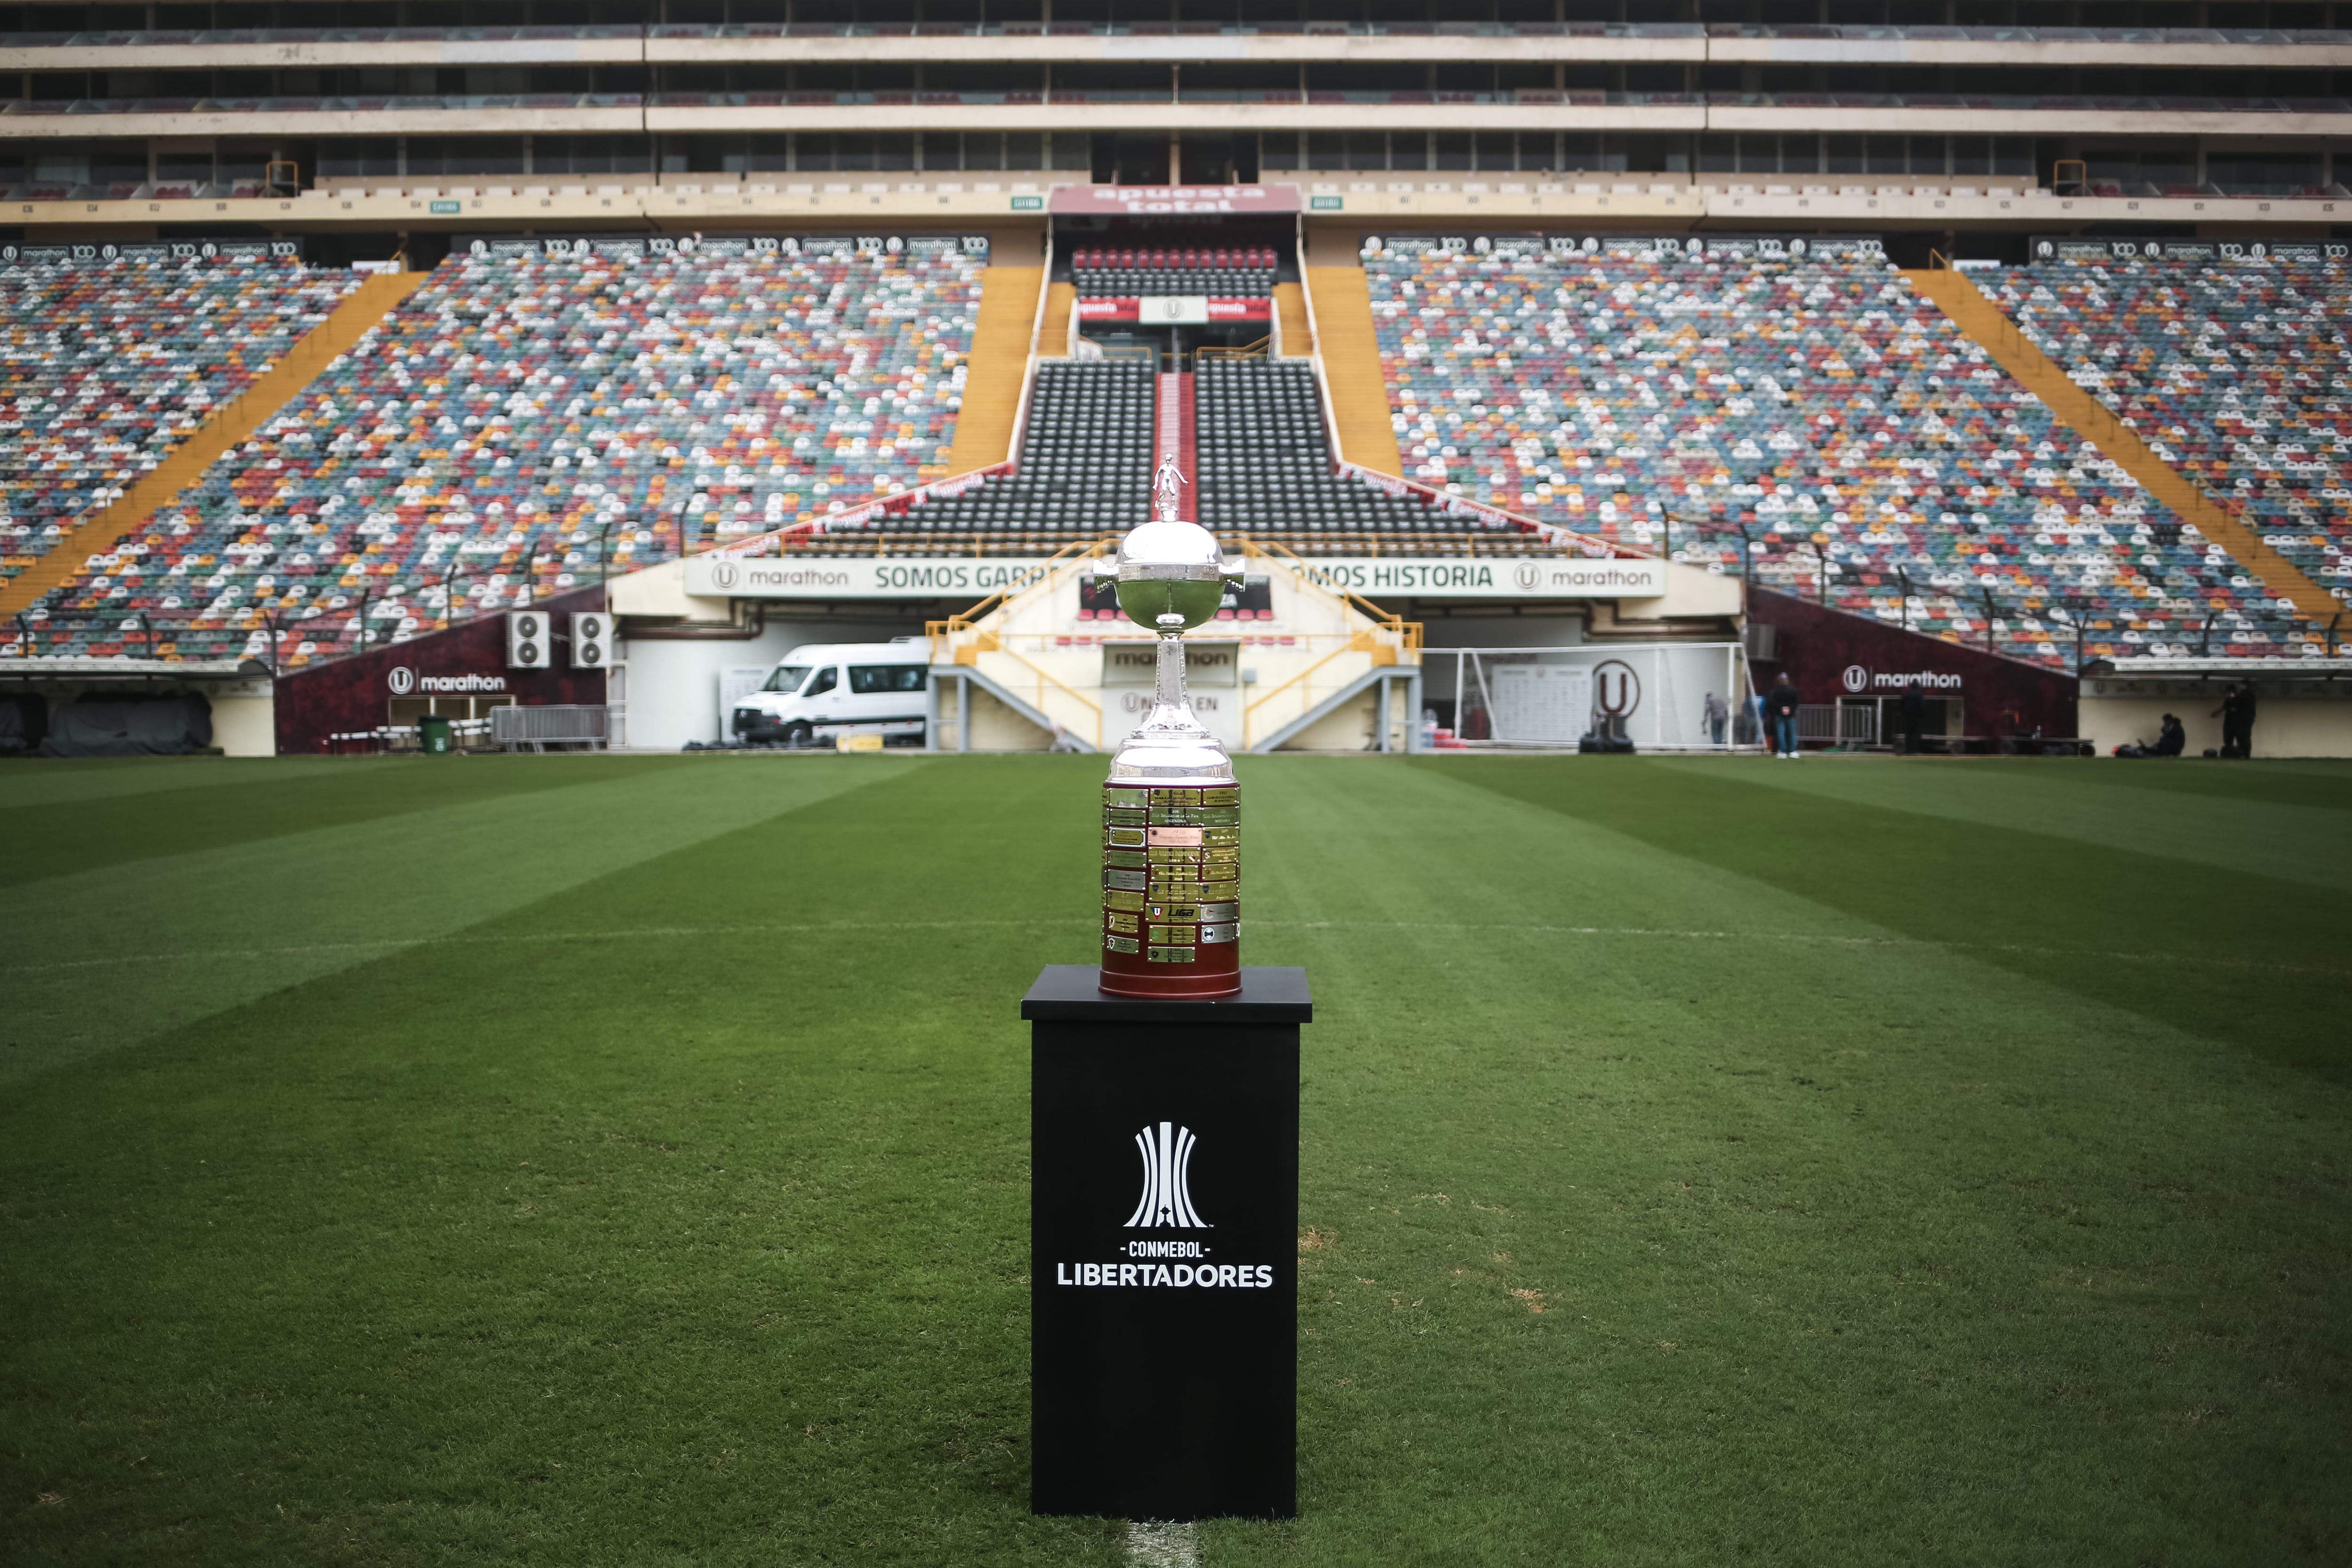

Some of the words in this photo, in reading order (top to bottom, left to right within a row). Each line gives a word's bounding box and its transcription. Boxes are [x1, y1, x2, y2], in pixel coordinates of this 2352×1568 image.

[1093, 186, 1265, 202] apuesta
[1128, 198, 1235, 213] total
[24, 249, 66, 257] marathon
[72, 245, 96, 258] 100
[123, 247, 167, 257] marathon
[171, 244, 196, 257] 100
[271, 242, 297, 256] 100
[648, 238, 675, 253] 100
[1440, 237, 1467, 251] 100
[1549, 238, 1575, 251] 100
[2112, 243, 2136, 257] 100
[2219, 244, 2243, 257] 100
[2274, 247, 2317, 256] marathon
[2324, 245, 2348, 257] 100
[719, 568, 732, 586] U
[749, 568, 849, 586] marathon
[875, 566, 968, 587] SOMOS
[976, 566, 1059, 587] GARR
[1375, 565, 1493, 587] HISTORIA
[1520, 567, 1534, 586] U
[1552, 568, 1652, 585] marathon
[1115, 650, 1229, 666] mahon
[393, 672, 408, 689] U
[421, 673, 506, 691] marathon
[1847, 670, 1862, 688] U
[1875, 670, 1961, 688] marathon
[1599, 672, 1627, 715] U
[1057, 1263, 1273, 1288] LIBERTADORES
